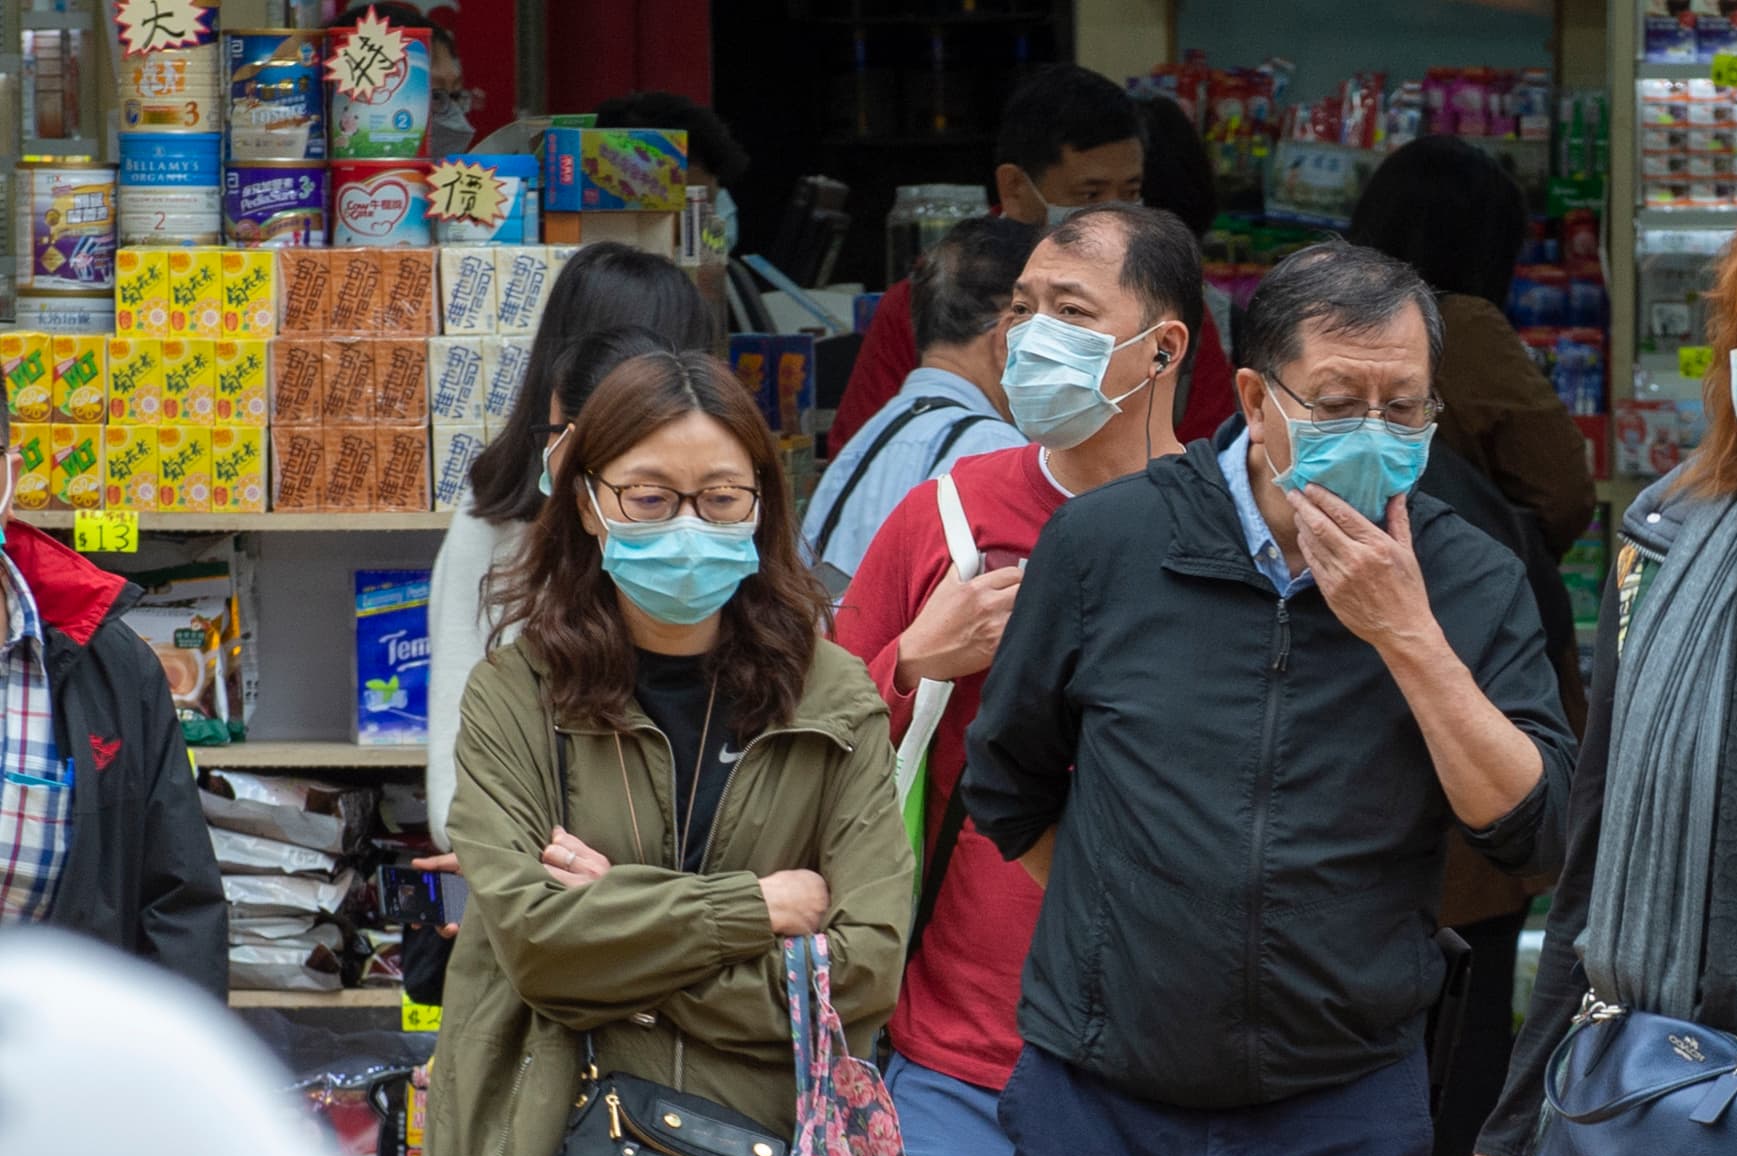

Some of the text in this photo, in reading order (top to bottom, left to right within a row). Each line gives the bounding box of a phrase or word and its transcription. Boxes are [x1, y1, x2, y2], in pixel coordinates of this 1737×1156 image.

[140, 0, 186, 49] 大
[397, 113, 409, 128] 2
[126, 158, 199, 172] BELLAMY'S
[154, 210, 167, 230] 2
[441, 171, 483, 220] 價
[120, 264, 162, 306] 菊花茶
[173, 264, 215, 307] 菊花茶
[226, 266, 268, 307] 菊花茶
[284, 257, 317, 329] 維他奶
[299, 264, 330, 331] vitasoy
[333, 257, 369, 329] 維他奶
[351, 263, 381, 330] vitasoy
[447, 255, 482, 327] 維他奶
[463, 261, 495, 329] vitasoy
[498, 255, 535, 326] 維他奶
[516, 261, 547, 328] vitasoy
[112, 352, 155, 394] 菊花茶
[165, 353, 208, 394] 菊花茶
[219, 354, 262, 395] 菊花茶
[432, 345, 469, 417] 維他奶
[451, 351, 483, 420] vitasoy
[485, 344, 523, 416] 維他奶
[109, 440, 150, 481] 菊花茶
[162, 440, 204, 481] 菊花茶
[215, 441, 258, 482] 菊花茶
[435, 432, 472, 504] 維他奶
[1668, 1034, 1705, 1061] COACH
